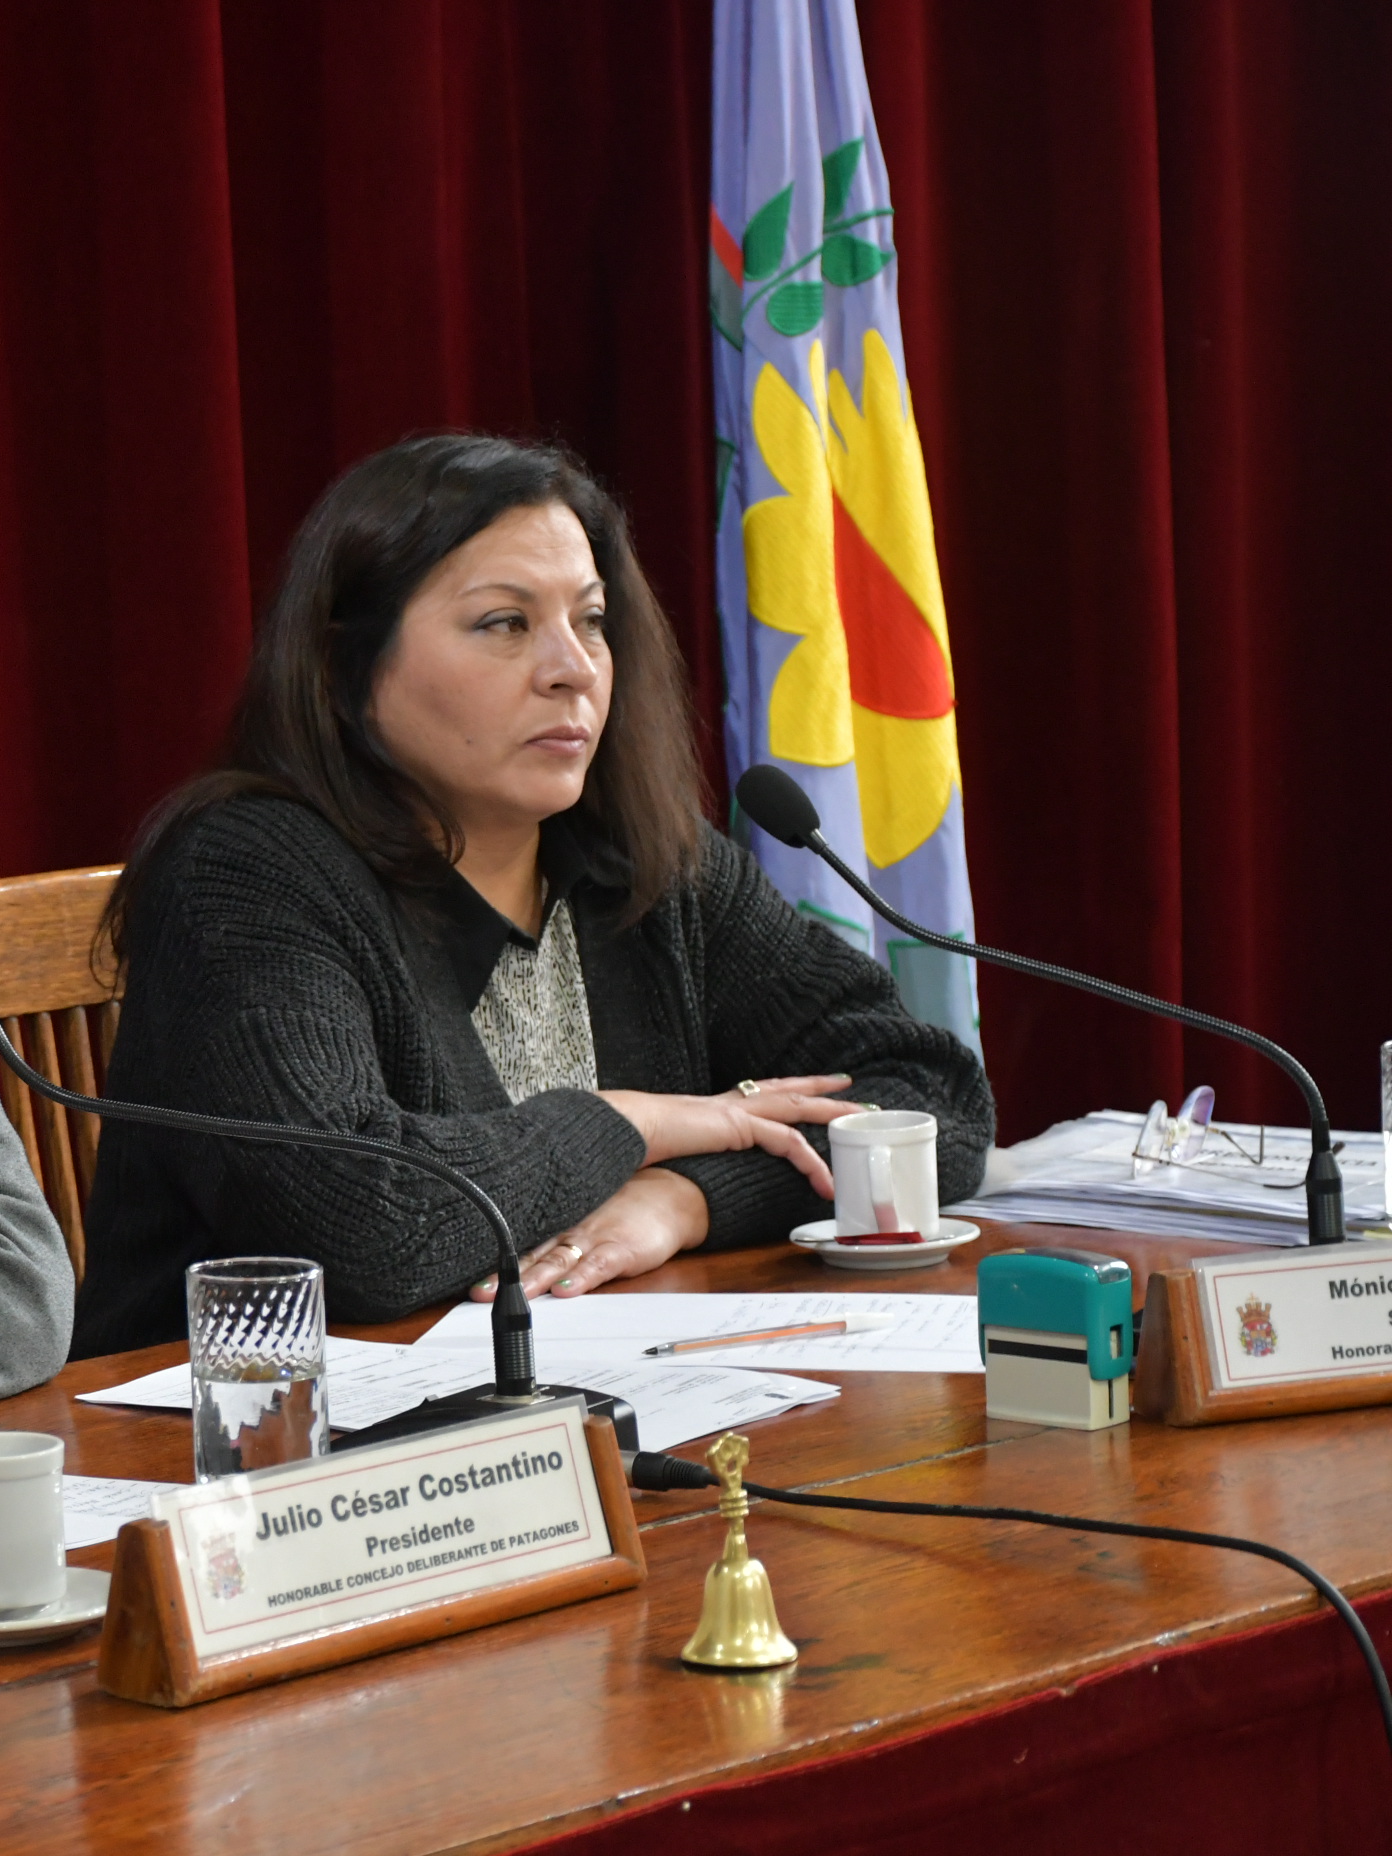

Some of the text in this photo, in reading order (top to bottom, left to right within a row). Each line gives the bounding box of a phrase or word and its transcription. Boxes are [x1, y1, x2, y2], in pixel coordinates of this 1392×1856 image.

[256, 1450, 564, 1541] Julio César Costantino
[365, 1515, 476, 1559] Presidente
[267, 1519, 580, 1608] HONORABLE CONCEJO DELIBERANTE DE PATAGONES
